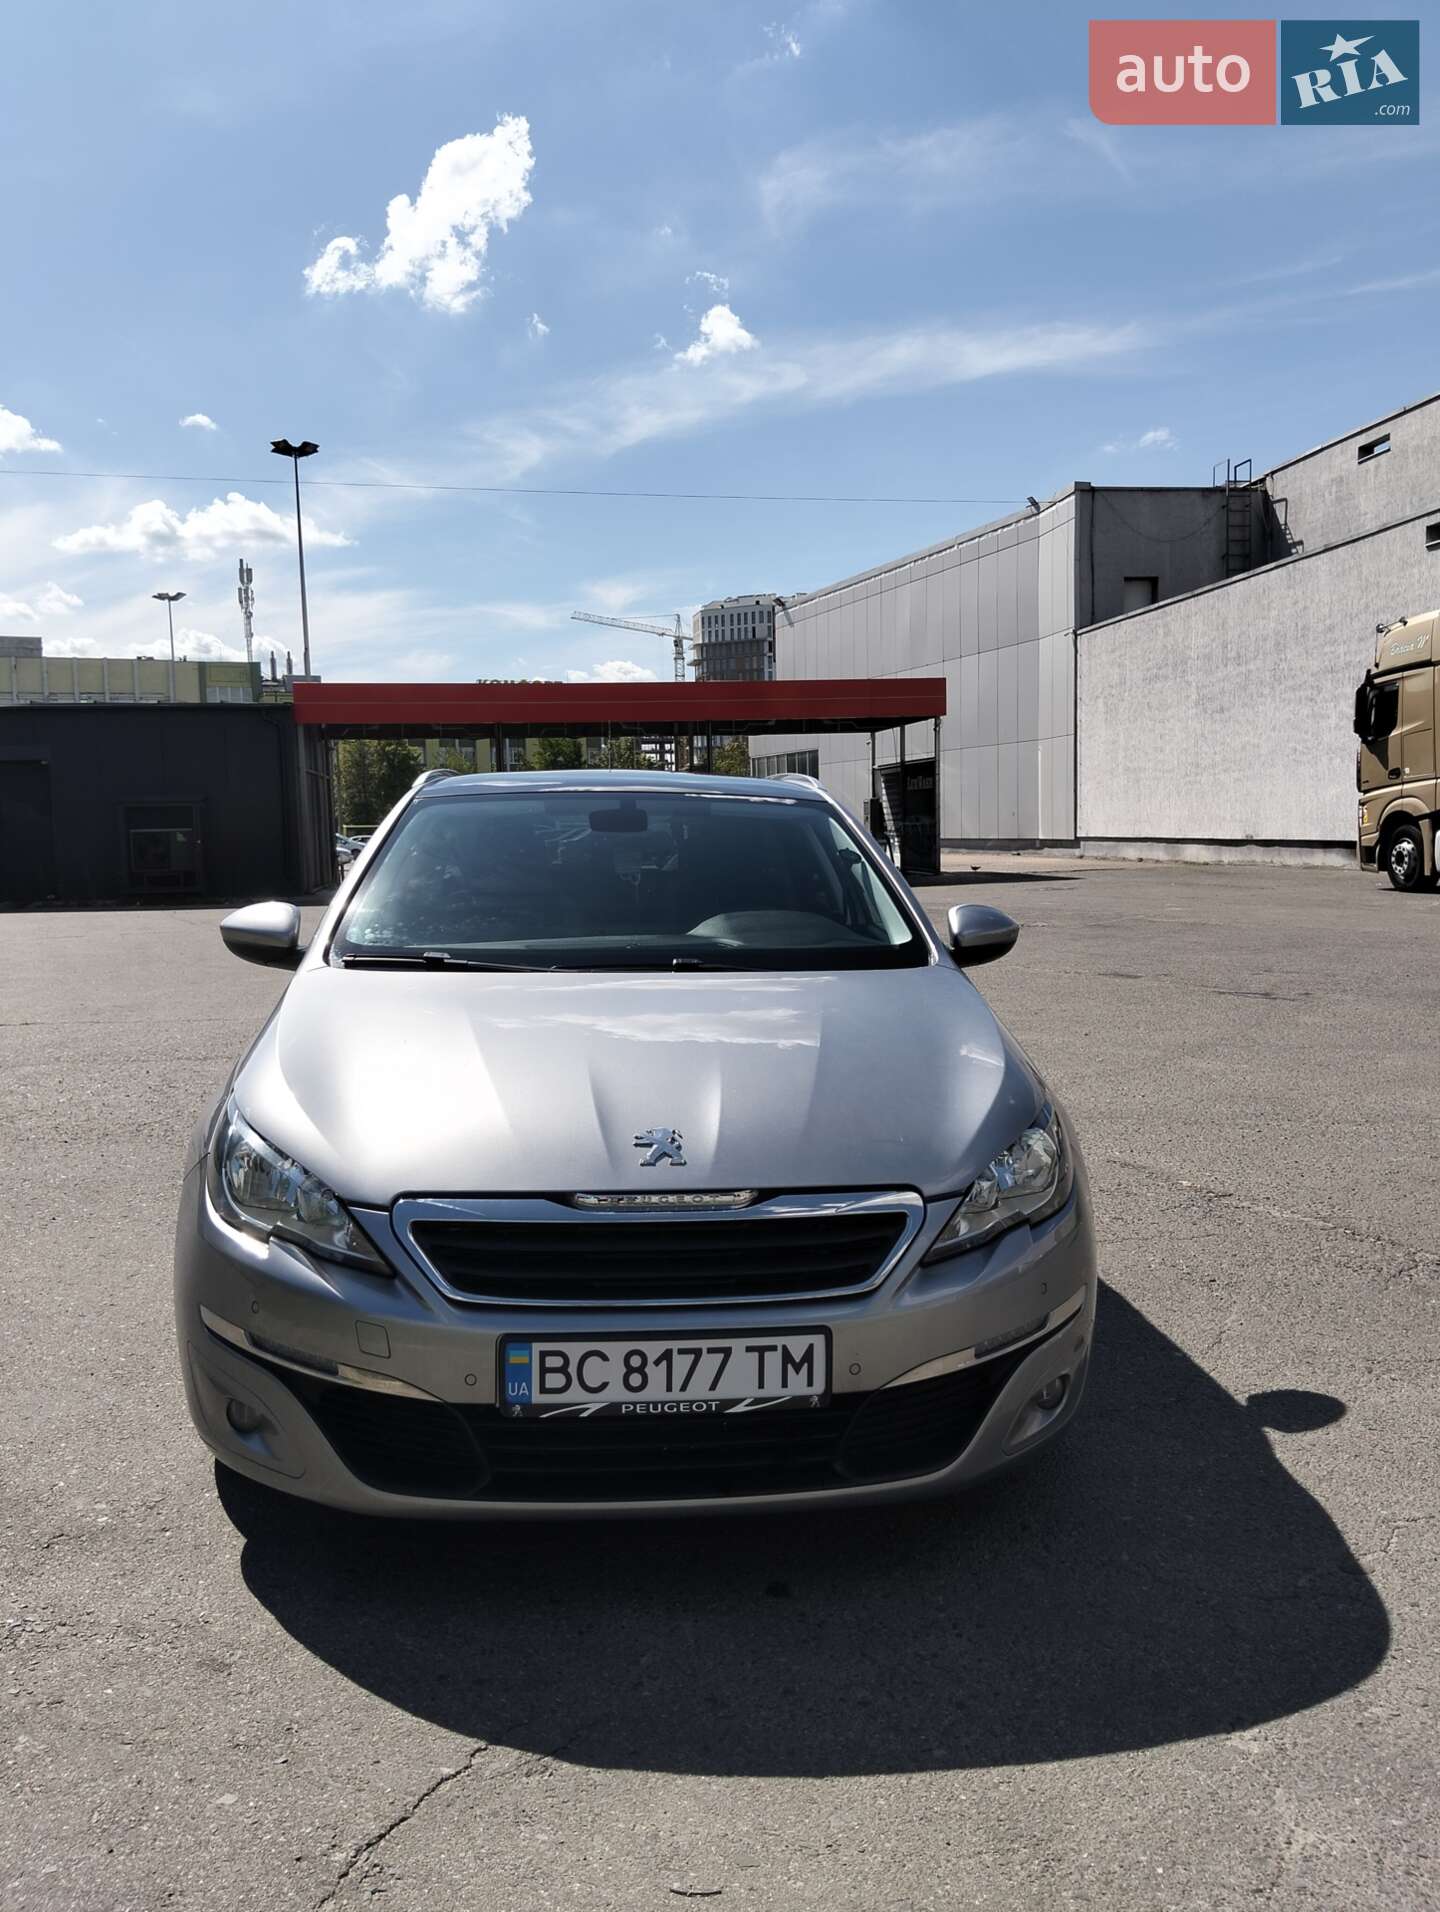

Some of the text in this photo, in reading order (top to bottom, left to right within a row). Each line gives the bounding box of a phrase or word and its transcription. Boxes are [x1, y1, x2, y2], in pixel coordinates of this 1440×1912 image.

[538, 1343, 815, 1395] BC 8177 TM
[507, 1382, 529, 1396] UA
[621, 1401, 721, 1414] PEUGEOT
